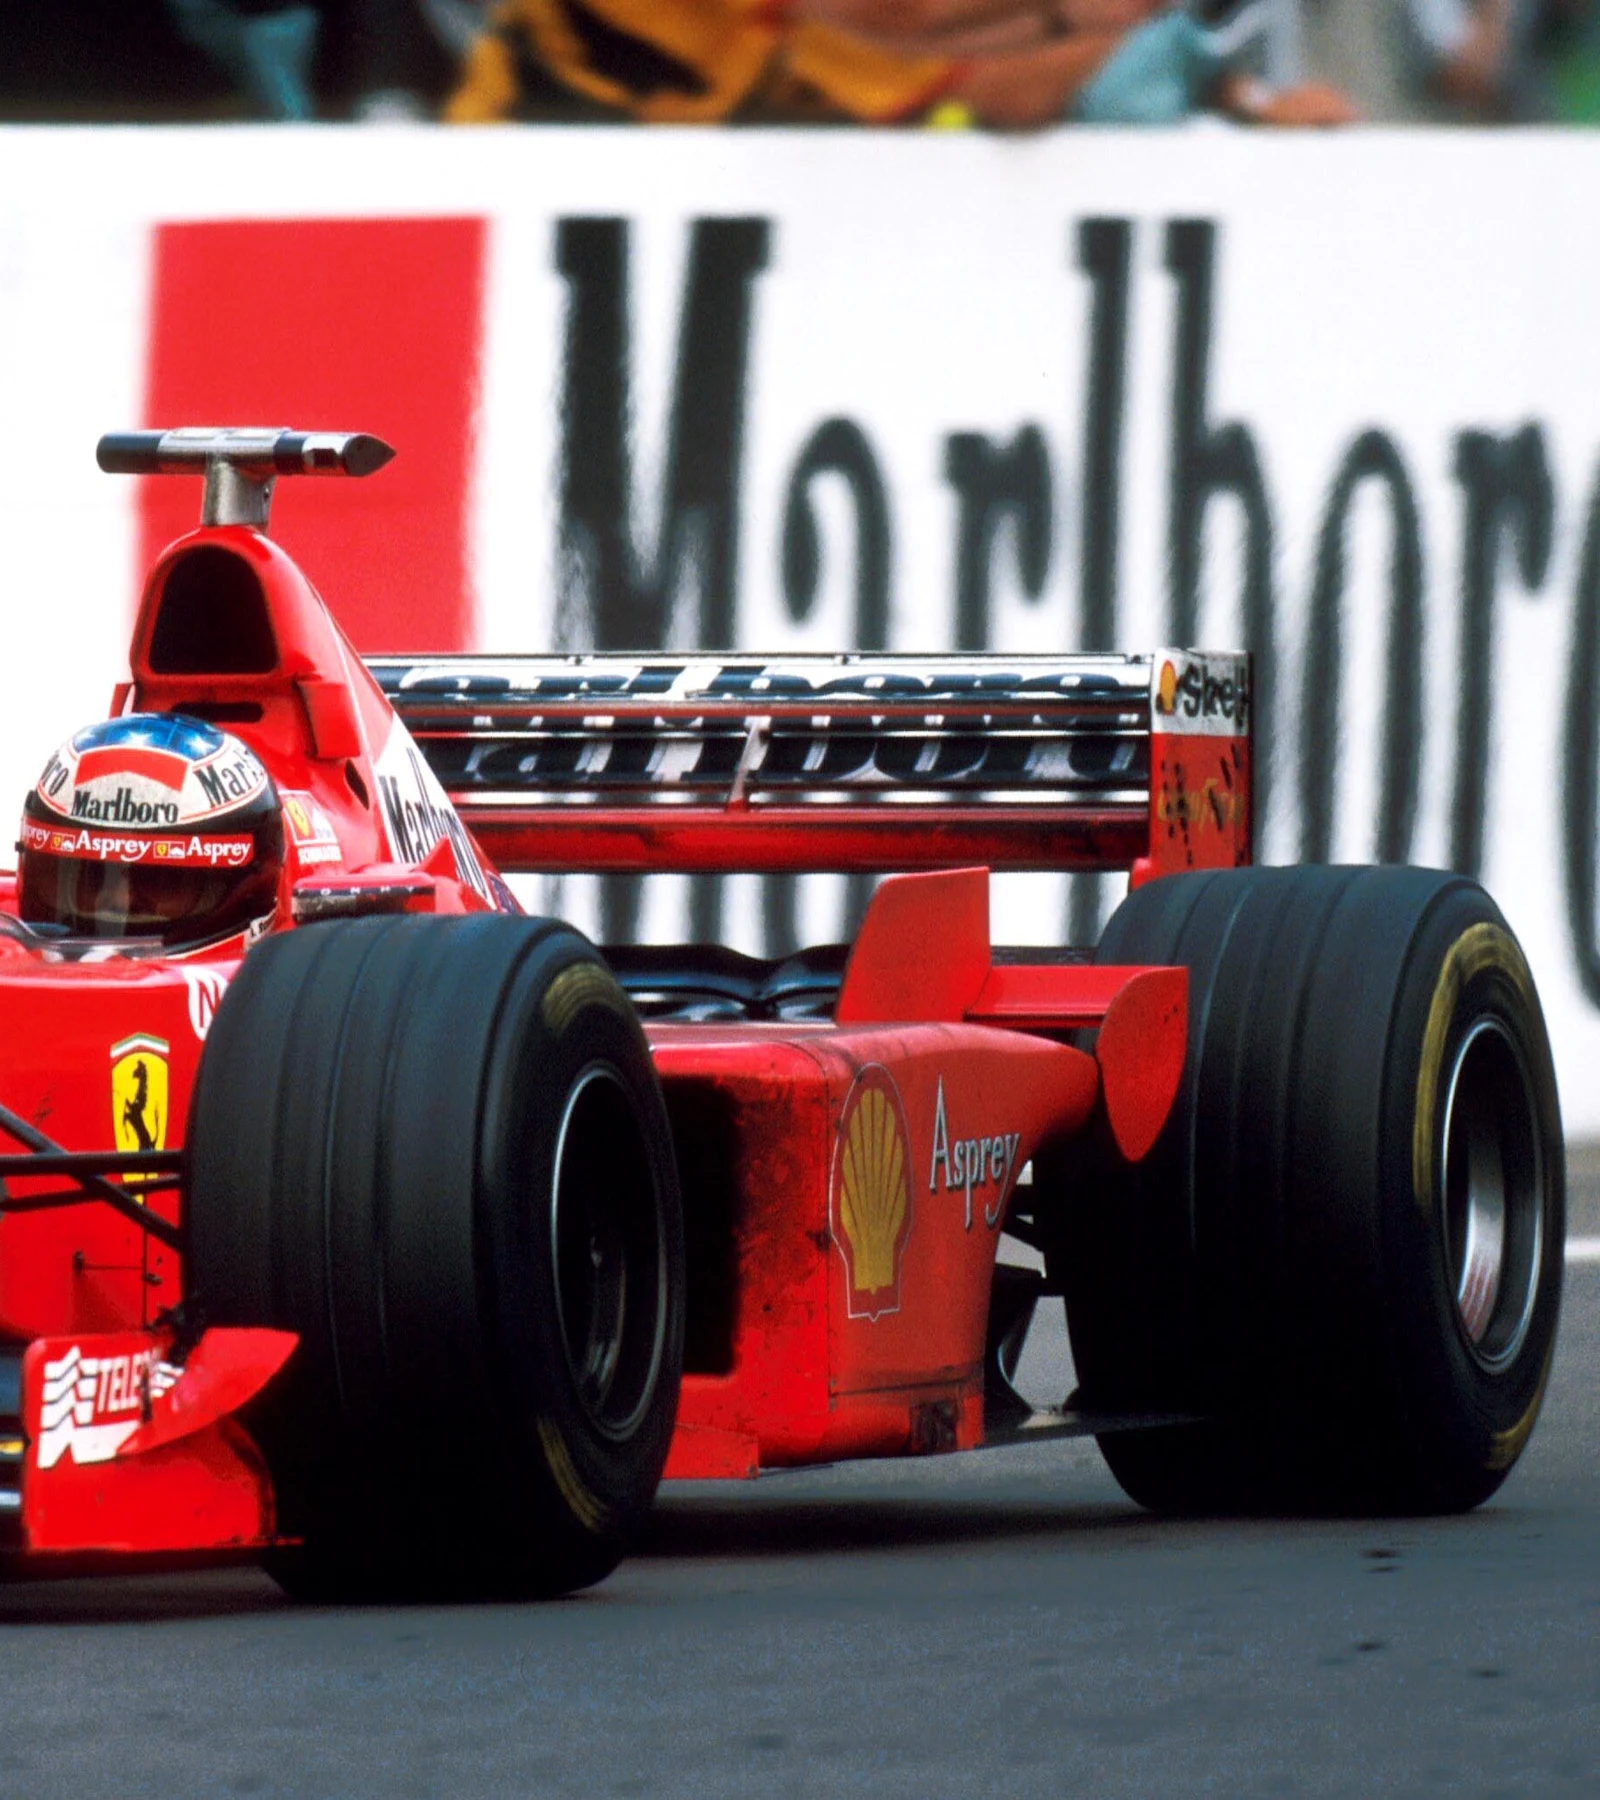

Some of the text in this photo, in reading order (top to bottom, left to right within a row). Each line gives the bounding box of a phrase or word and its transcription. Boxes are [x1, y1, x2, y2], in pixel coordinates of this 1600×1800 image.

[71, 787, 179, 825] Marlboro
[76, 830, 152, 862] Asprey
[187, 836, 251, 866] Asprey
[929, 1074, 1020, 1229] Asprey
[97, 1348, 157, 1412] TELE
